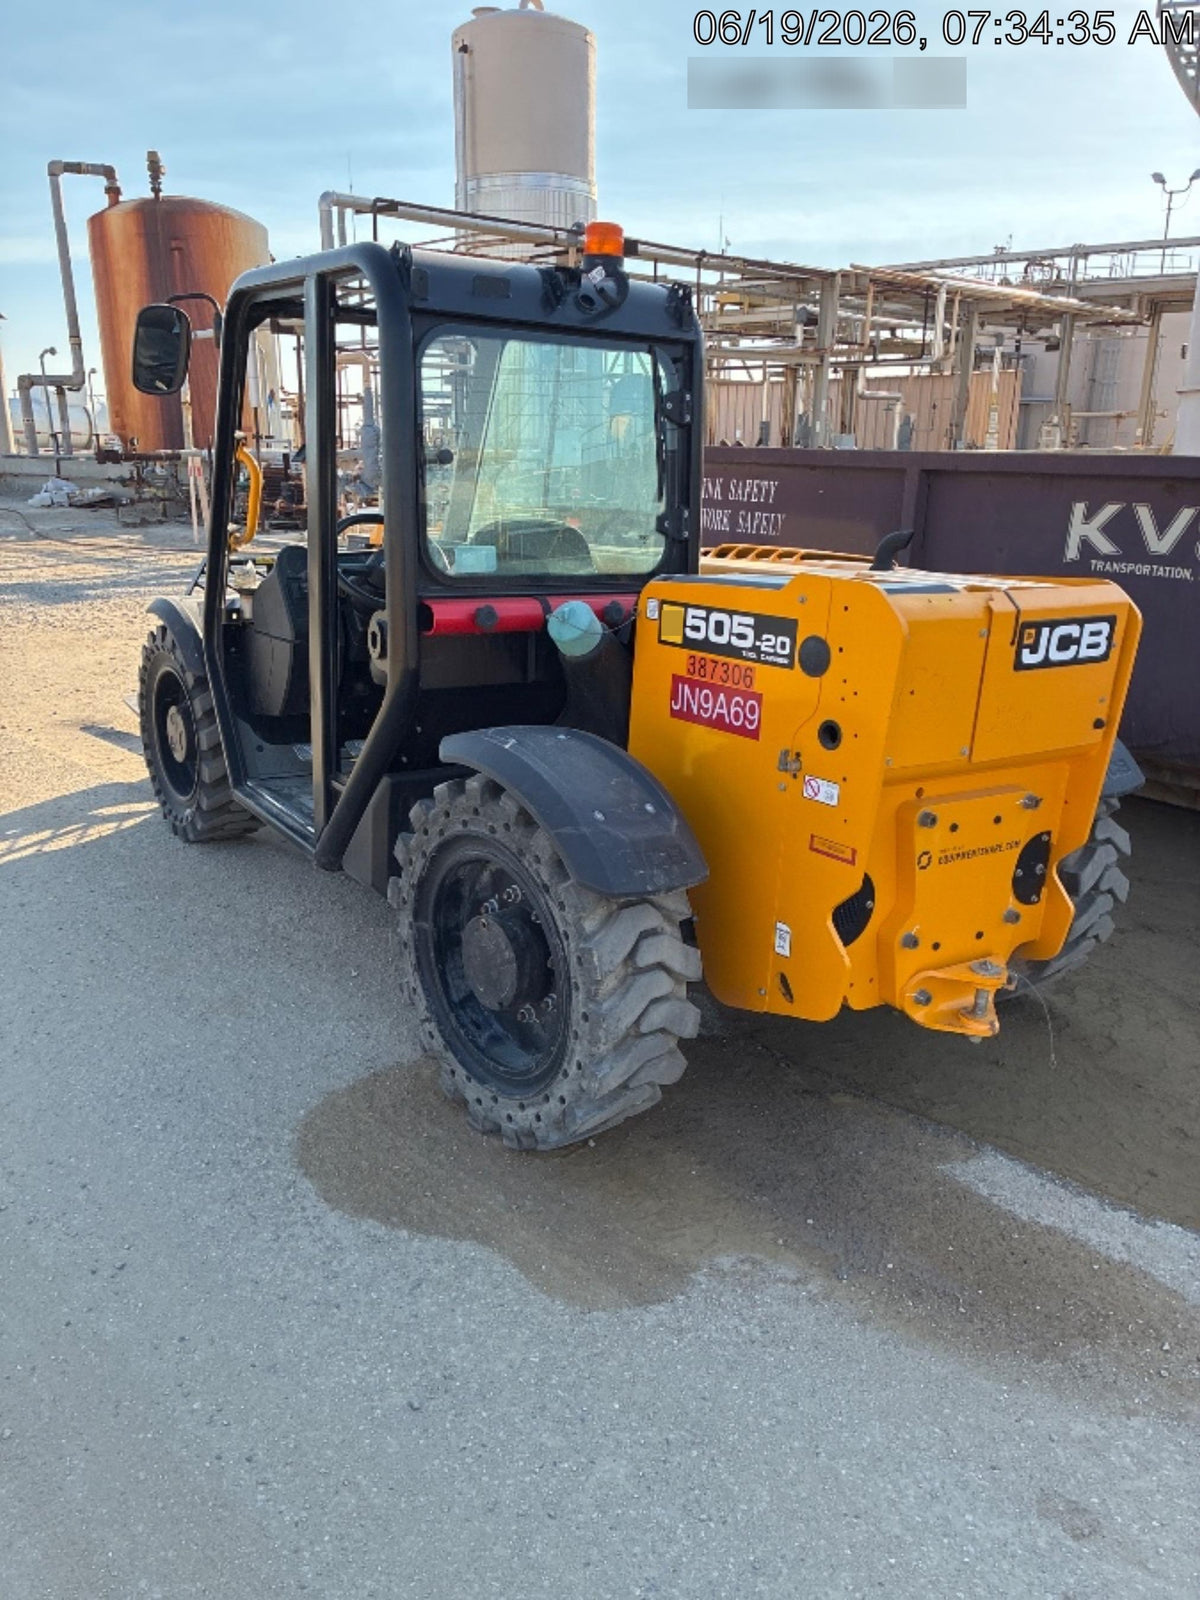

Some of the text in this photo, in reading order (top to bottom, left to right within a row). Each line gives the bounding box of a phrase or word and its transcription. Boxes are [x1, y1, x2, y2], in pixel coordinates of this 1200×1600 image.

[729, 478, 779, 503] SAFETY
[736, 510, 786, 535] SAFELY
[1063, 501, 1200, 562] KV
[1022, 621, 1110, 664] JCB
[687, 655, 753, 689] 387306
[671, 682, 760, 730] JN9A69
